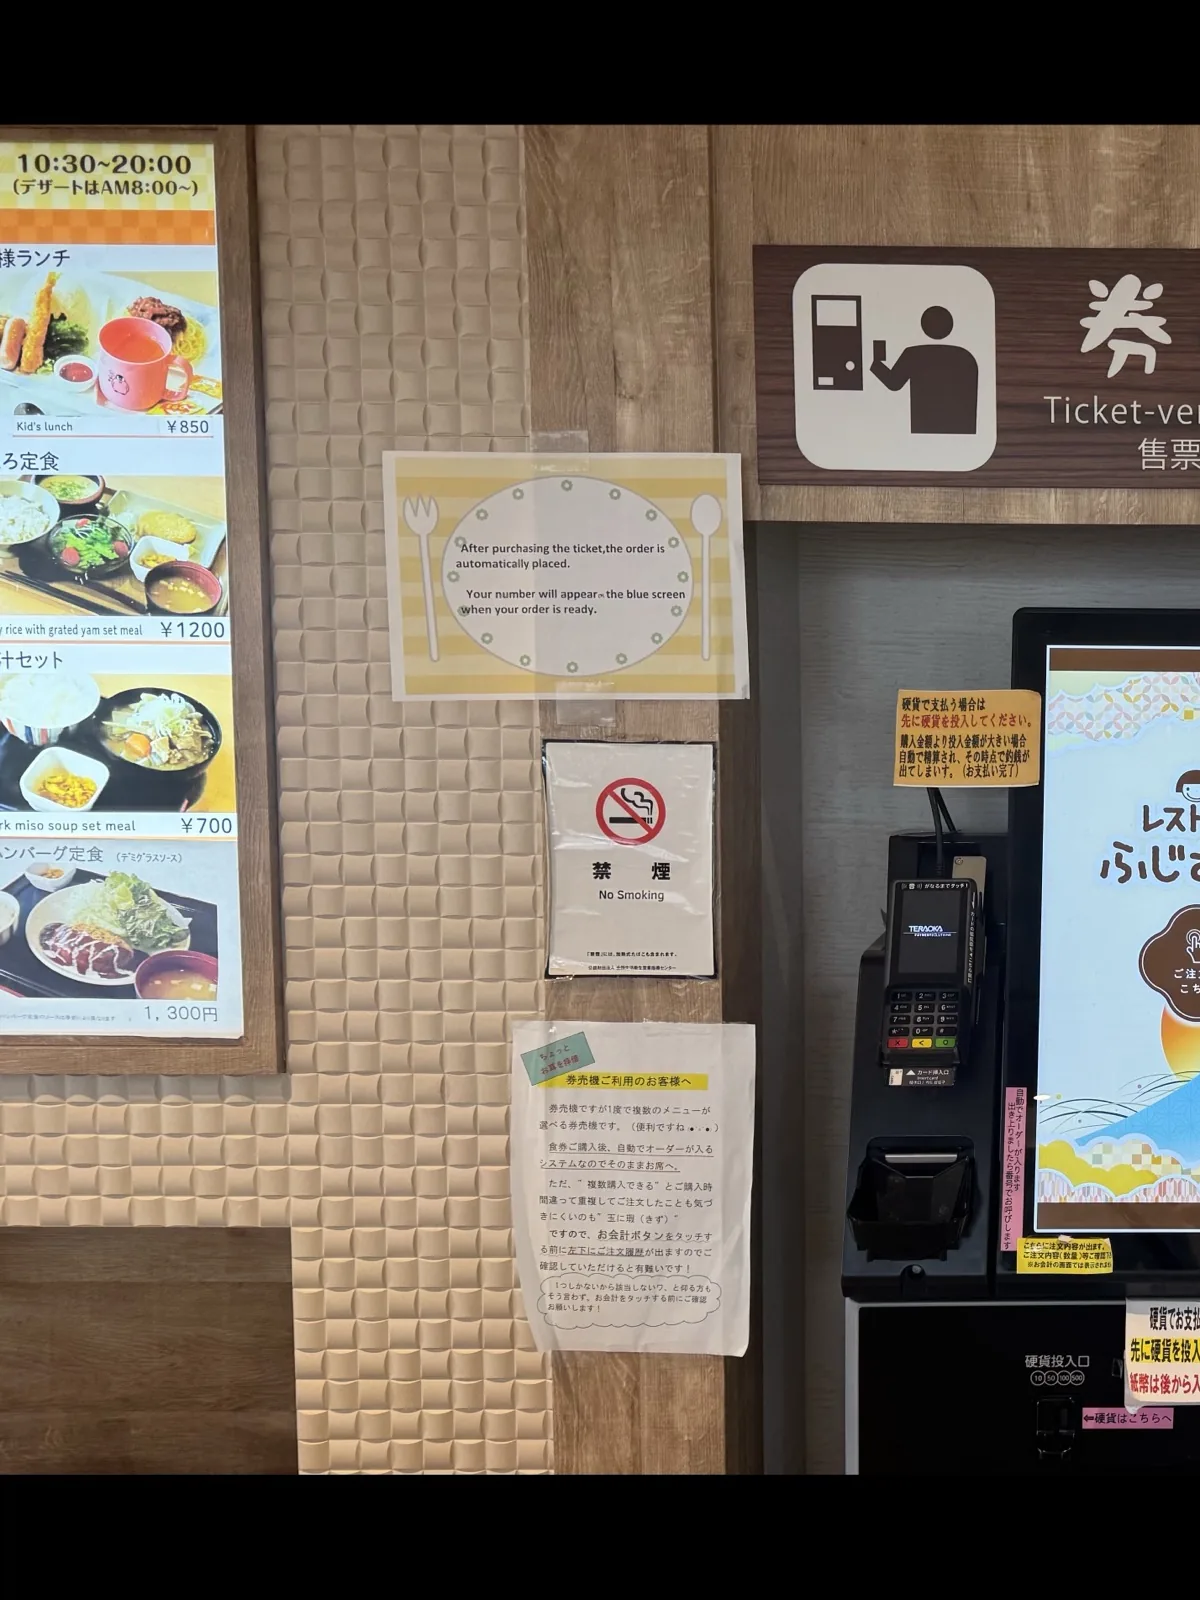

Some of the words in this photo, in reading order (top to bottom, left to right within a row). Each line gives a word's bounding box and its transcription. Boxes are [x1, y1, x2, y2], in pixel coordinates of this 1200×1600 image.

[16, 421, 42, 432] Kid's
[43, 421, 74, 432] lunch
[166, 419, 210, 434] ¥850
[460, 543, 490, 554] After
[492, 542, 550, 556] purchasing
[552, 543, 570, 554] the
[625, 543, 655, 554] order
[656, 543, 666, 554] is
[455, 557, 530, 571] automatically
[531, 557, 571, 571] placed.
[466, 589, 493, 600] Your
[495, 589, 536, 600] number
[538, 588, 559, 600] will
[560, 590, 599, 603] appear
[606, 589, 624, 600] the
[626, 589, 650, 600] blue
[651, 590, 686, 600] screen
[461, 604, 492, 615] when
[494, 606, 519, 618] your
[521, 604, 550, 615] order
[552, 604, 562, 615] is
[563, 604, 598, 618] ready.
[5, 624, 23, 635] rice
[25, 622, 46, 635] with
[48, 622, 79, 637] grated
[80, 626, 101, 637] yam
[102, 624, 118, 635] set
[119, 623, 144, 636] meal
[160, 621, 226, 638] ¥1200
[901, 696, 986, 712] 硬貨で支払う場合は
[900, 713, 1032, 729] 先に硬貨を投入してください。
[900, 733, 1028, 749] 購入金額より投入金額が大きい場合
[15, 820, 45, 831] miso
[47, 821, 79, 833] soup
[83, 821, 103, 832] set
[105, 820, 137, 832] meal
[181, 817, 233, 834] ¥700
[0, 846, 104, 862] ンバーグ定食
[599, 890, 614, 900] No
[617, 890, 665, 902] Smoking
[565, 1074, 692, 1087] 券売機ご利用のお客様へ
[1025, 1355, 1090, 1368] 硬貨投入口
